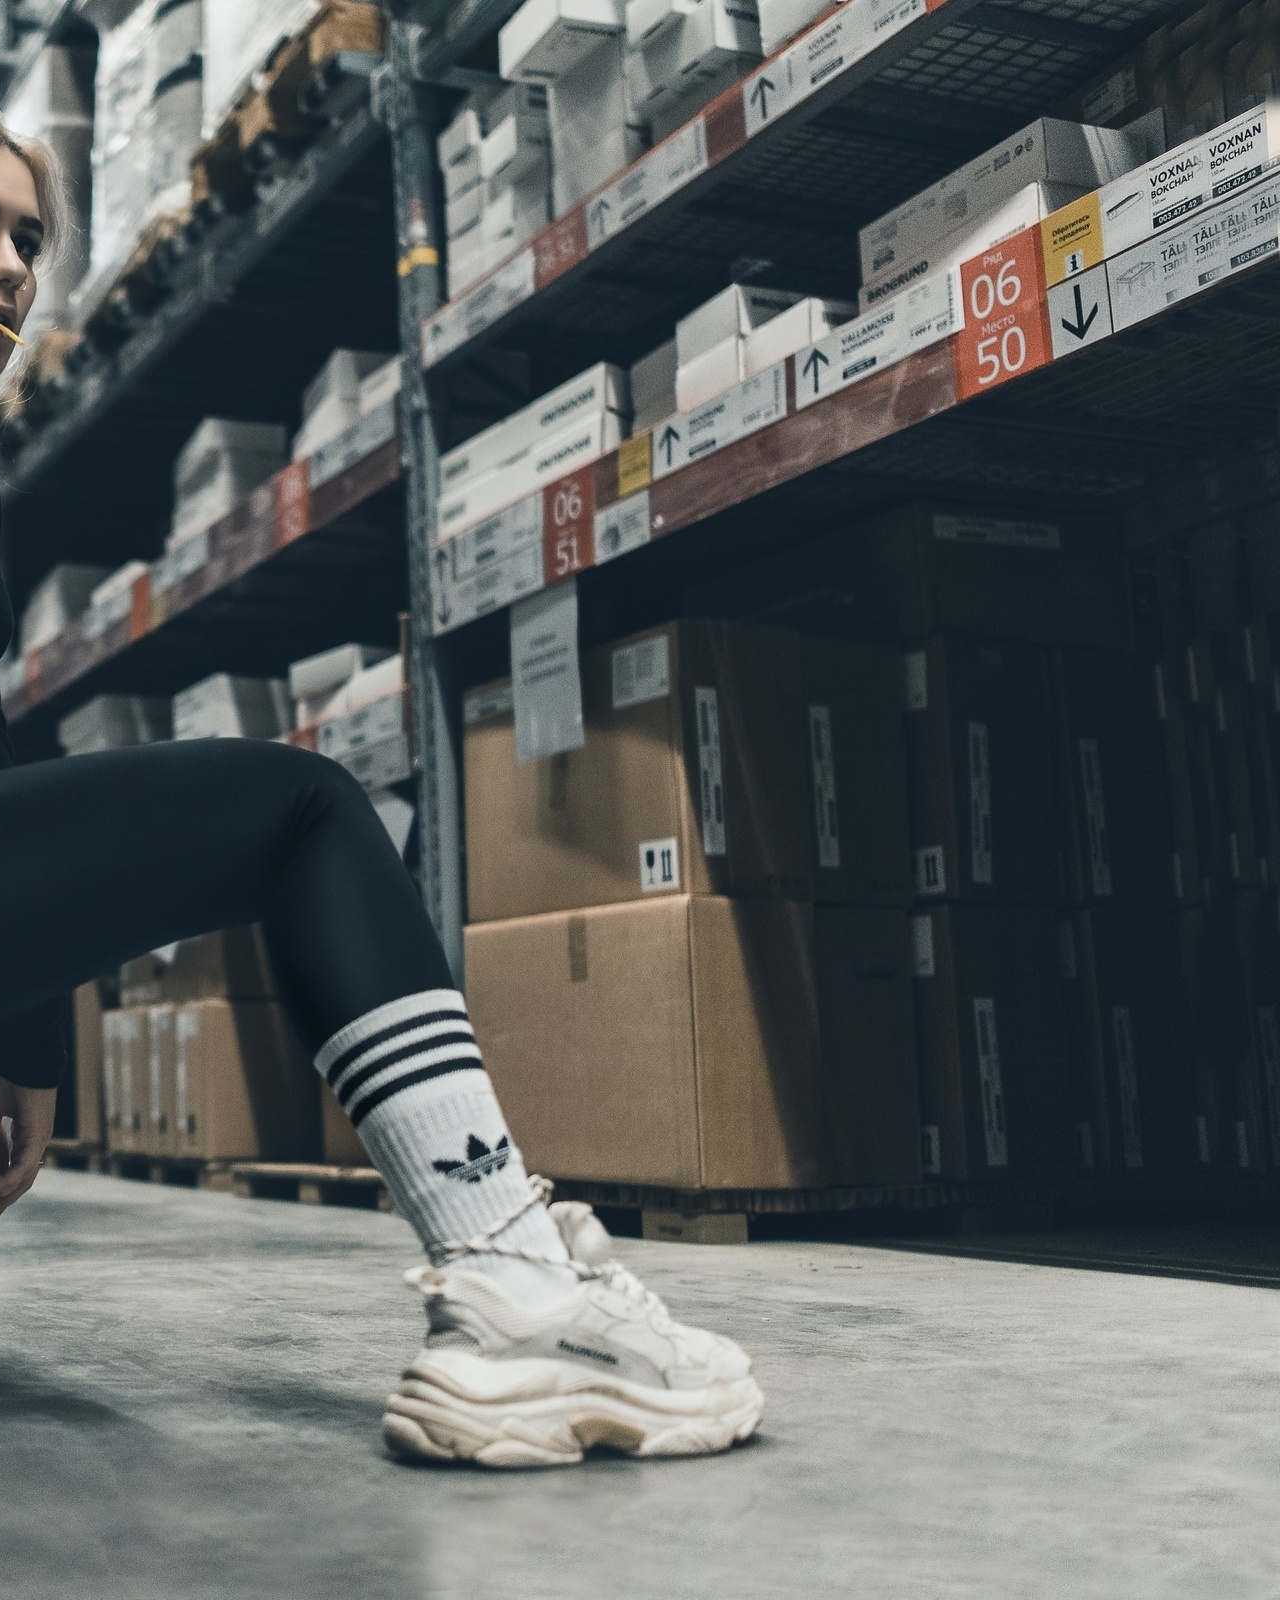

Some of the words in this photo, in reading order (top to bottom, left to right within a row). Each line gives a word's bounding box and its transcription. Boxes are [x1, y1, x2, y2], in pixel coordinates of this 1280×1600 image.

[1208, 122, 1262, 158] VOXNAN
[1209, 141, 1254, 170] ВОКСНАН
[1150, 170, 1194, 200] ВОКСНАН
[1217, 169, 1257, 194] 003.472.42
[1157, 199, 1198, 224] 003.472.42
[971, 259, 1021, 319] 06
[981, 314, 1015, 336] Место
[977, 325, 1027, 385] 50
[553, 482, 582, 526] 06
[556, 536, 581, 577] 51
